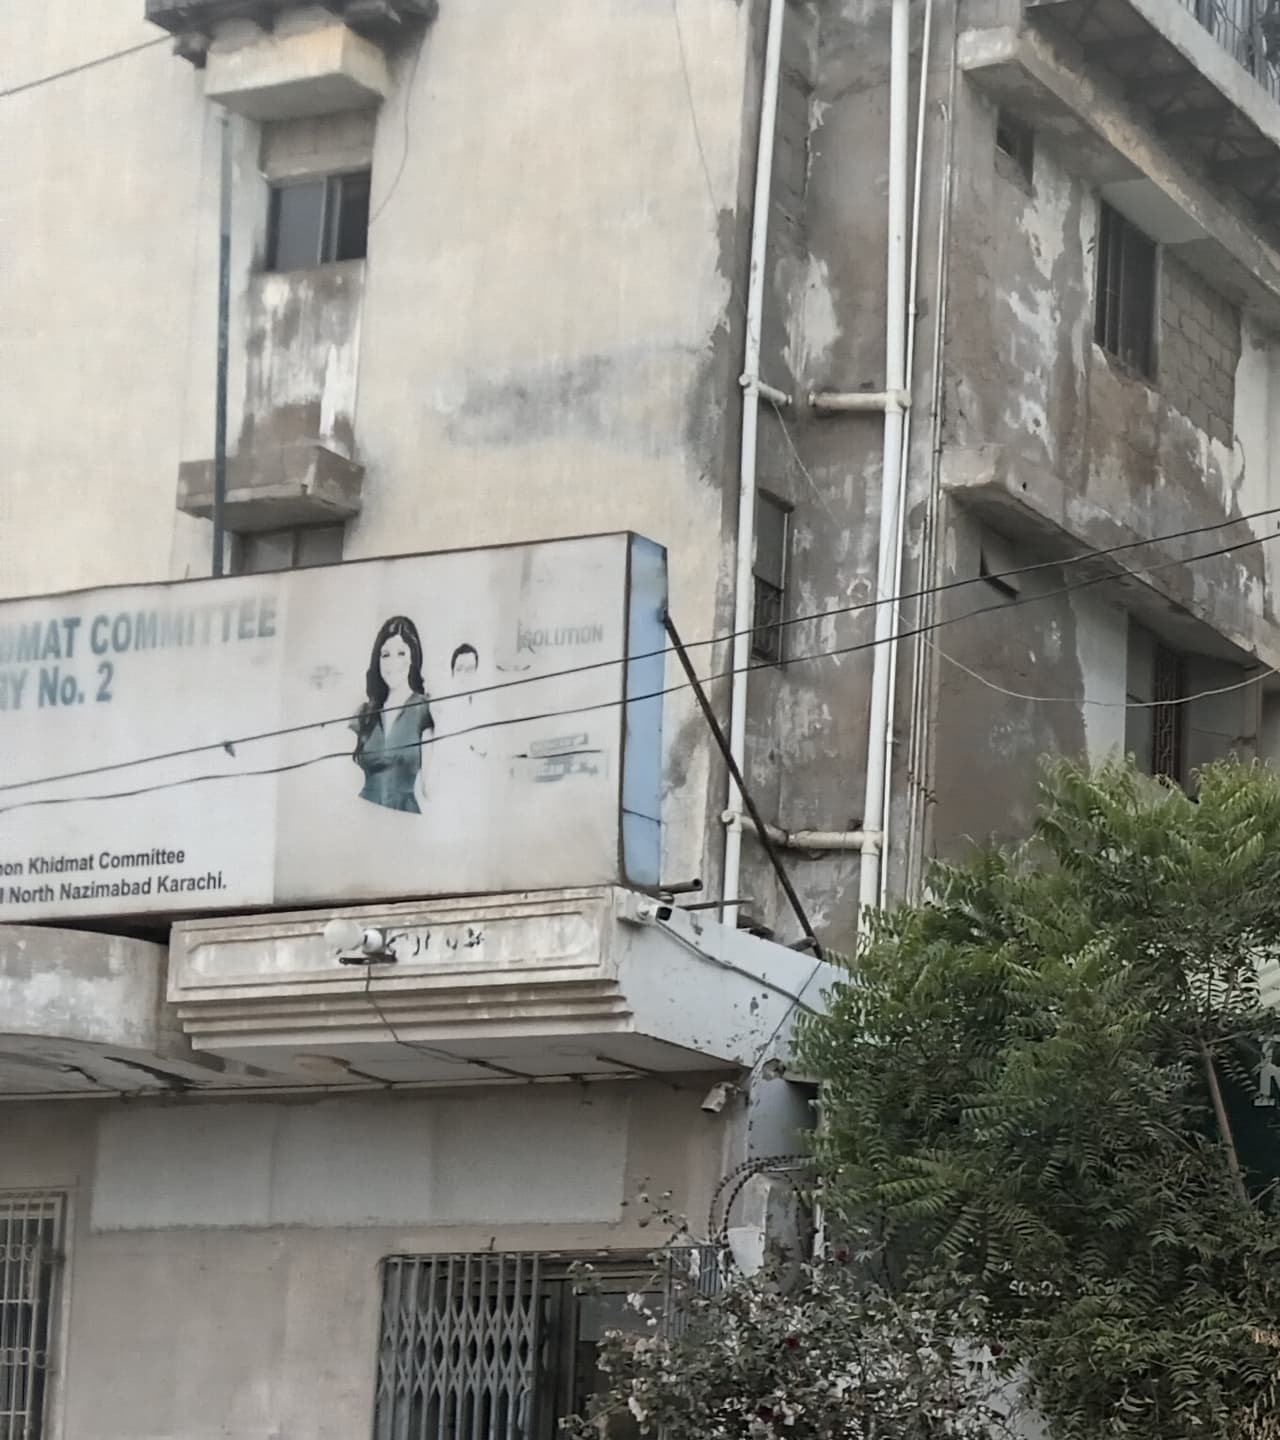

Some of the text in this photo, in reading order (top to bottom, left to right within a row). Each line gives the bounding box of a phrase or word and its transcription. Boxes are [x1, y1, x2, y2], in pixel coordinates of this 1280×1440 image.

[90, 598, 277, 655] COMMITTEE
[38, 666, 85, 708] No.
[96, 661, 114, 702] 2
[0, 848, 185, 876] on Khidmat Committee
[9, 884, 54, 904] North
[59, 877, 152, 901] Nazimabad
[157, 870, 227, 894] Karachi.
